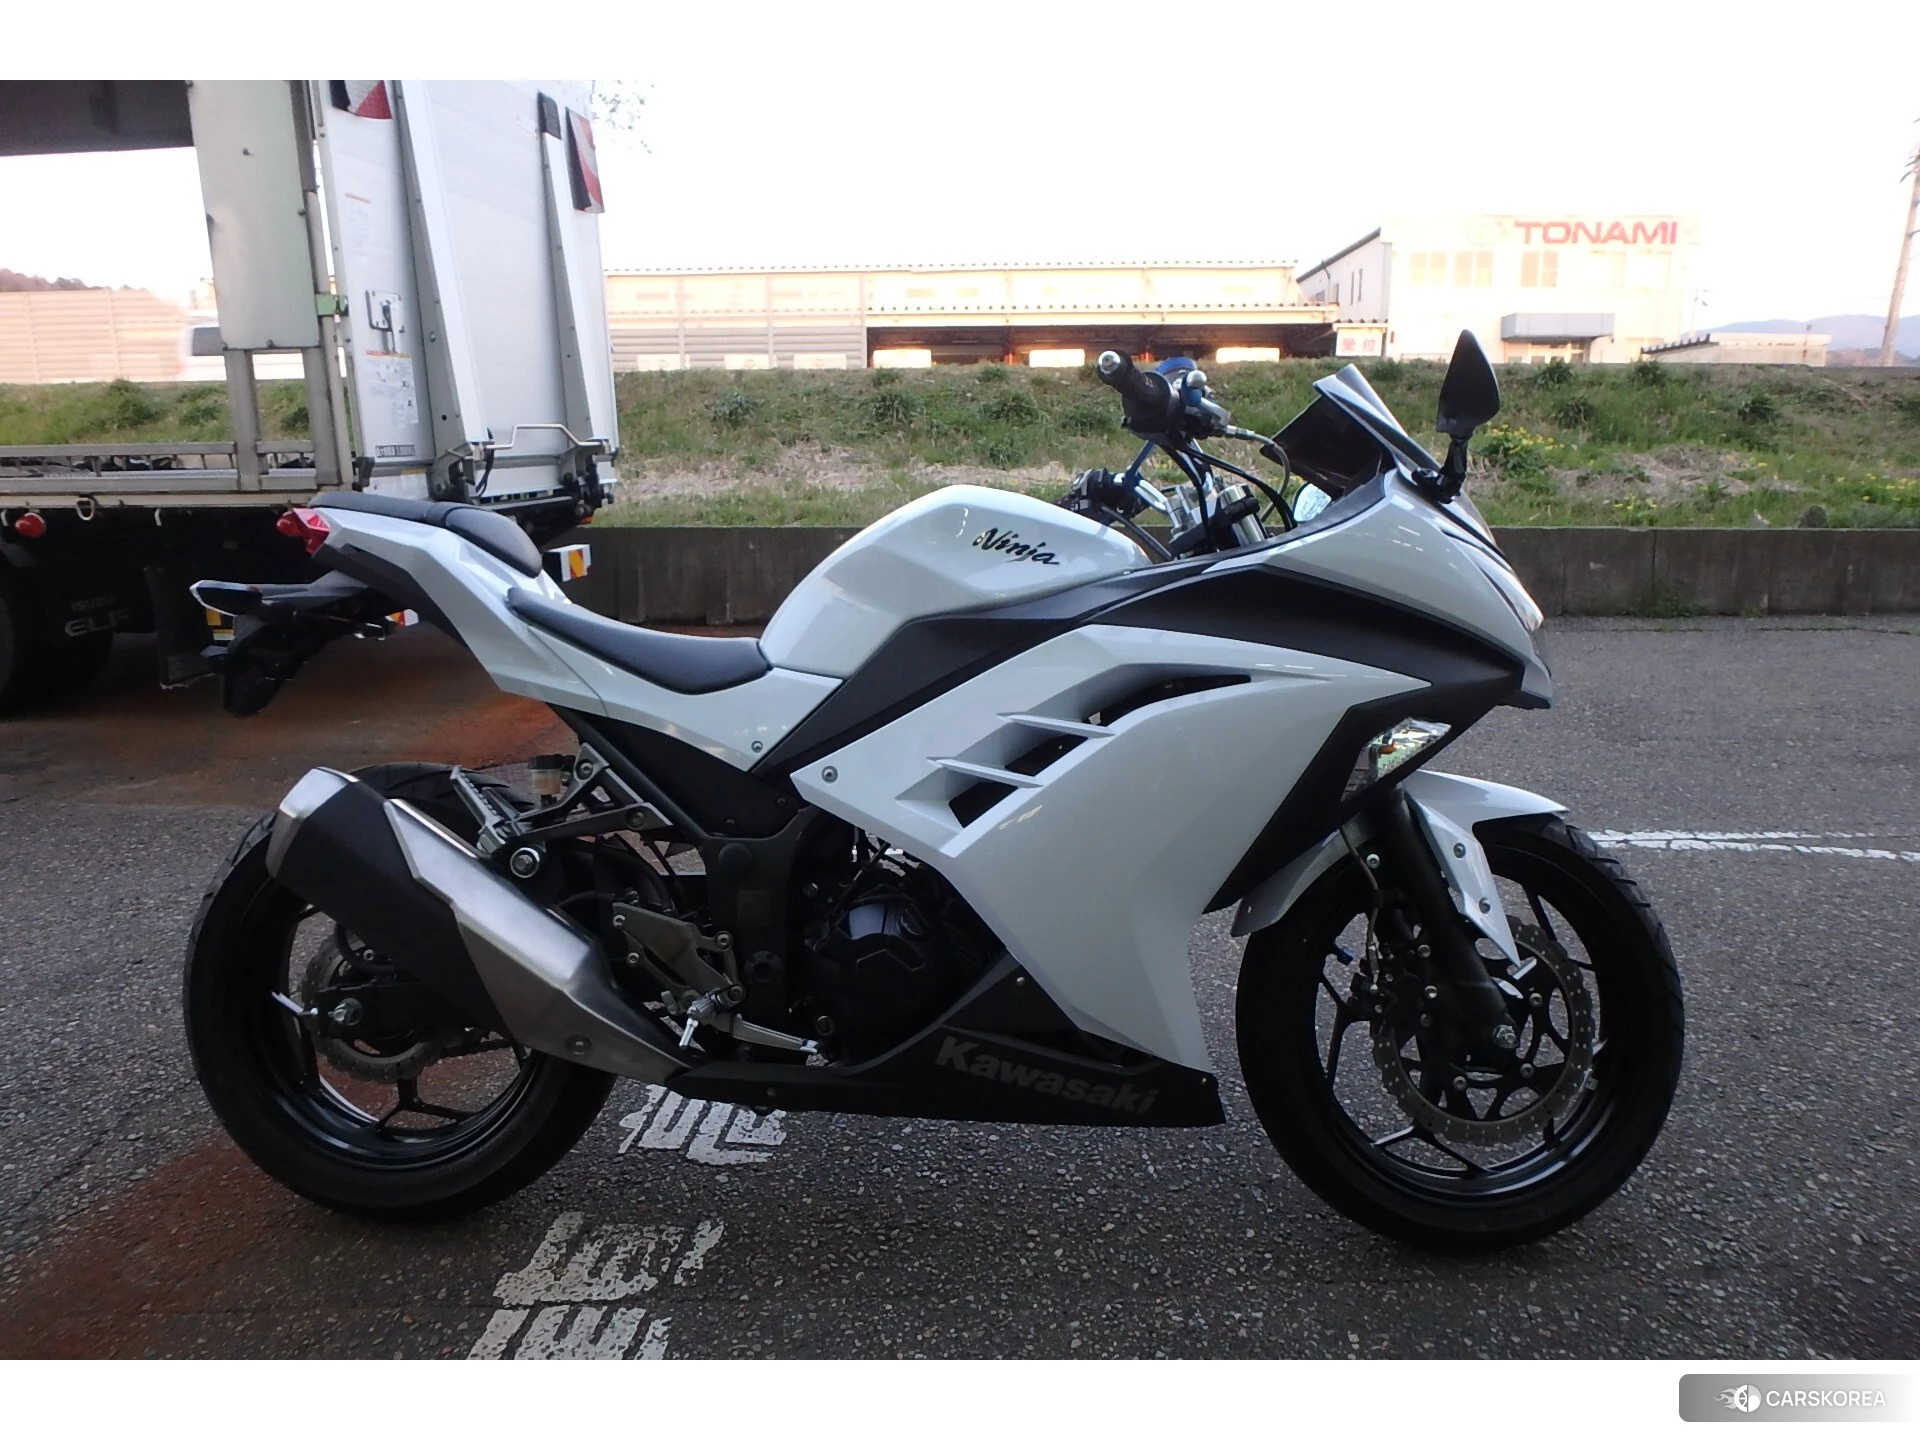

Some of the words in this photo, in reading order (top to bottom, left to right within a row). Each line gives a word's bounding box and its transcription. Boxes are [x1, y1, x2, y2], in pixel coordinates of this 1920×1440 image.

[1514, 220, 1678, 244] TONAMI
[972, 528, 1060, 565] Ninja
[70, 595, 115, 612] ISUZU
[65, 608, 129, 637] ELF
[935, 1036, 1159, 1114] Kawasaki
